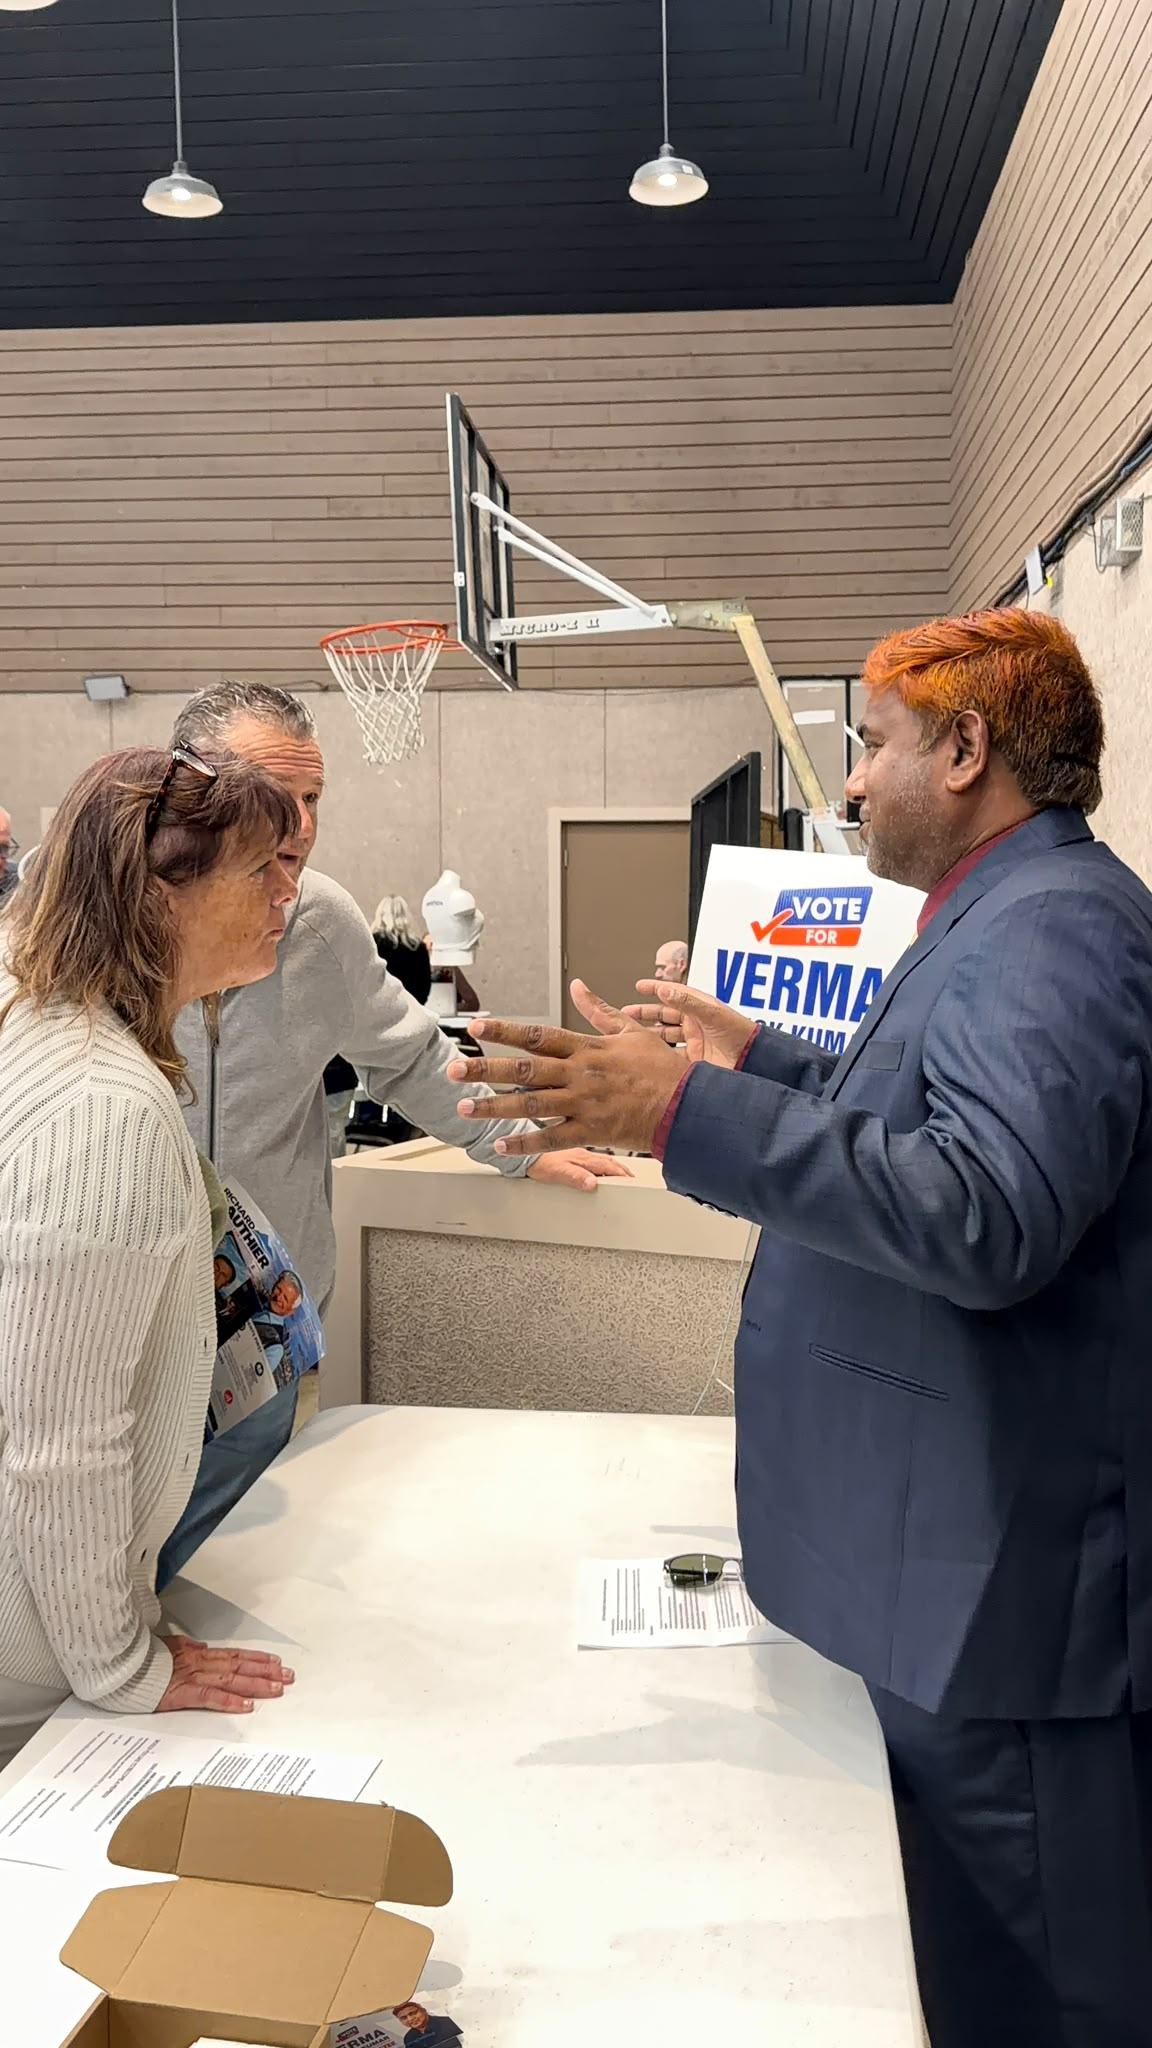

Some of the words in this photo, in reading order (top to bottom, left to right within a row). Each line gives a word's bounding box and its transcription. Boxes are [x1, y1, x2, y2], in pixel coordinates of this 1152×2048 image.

[792, 897, 862, 921] VOTE
[805, 929, 838, 944] FOR
[715, 949, 884, 1023] VERMA
[224, 1187, 255, 1230] RICHARD
[228, 1205, 270, 1270] AUTHIER
